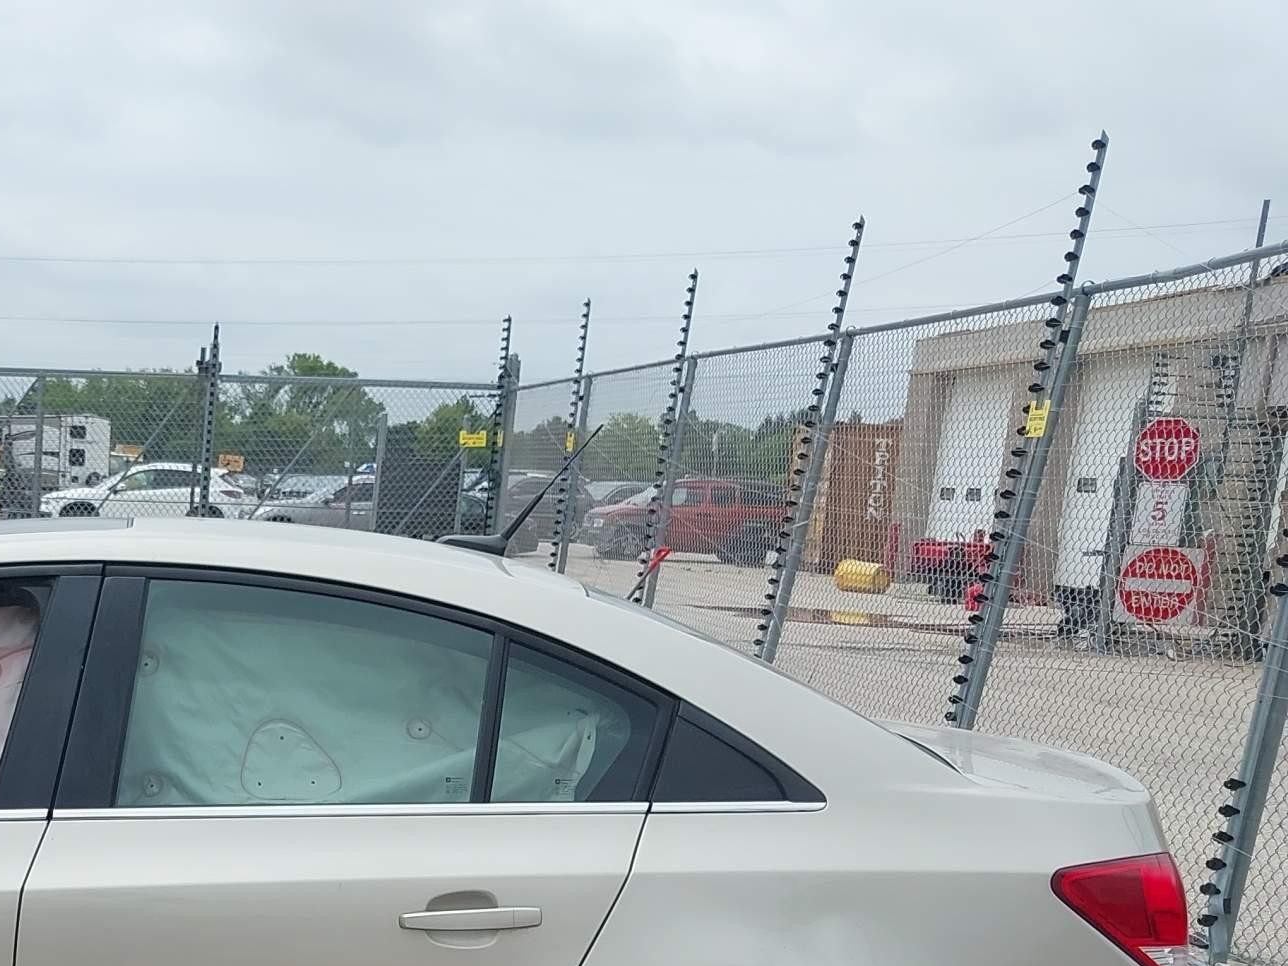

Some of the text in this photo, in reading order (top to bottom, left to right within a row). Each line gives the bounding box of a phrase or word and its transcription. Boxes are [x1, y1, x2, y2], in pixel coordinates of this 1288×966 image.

[1139, 438, 1194, 461] STOP
[1151, 501, 1168, 521] 5
[1136, 562, 1189, 575] DO NOT
[1132, 595, 1179, 608] ENTER
